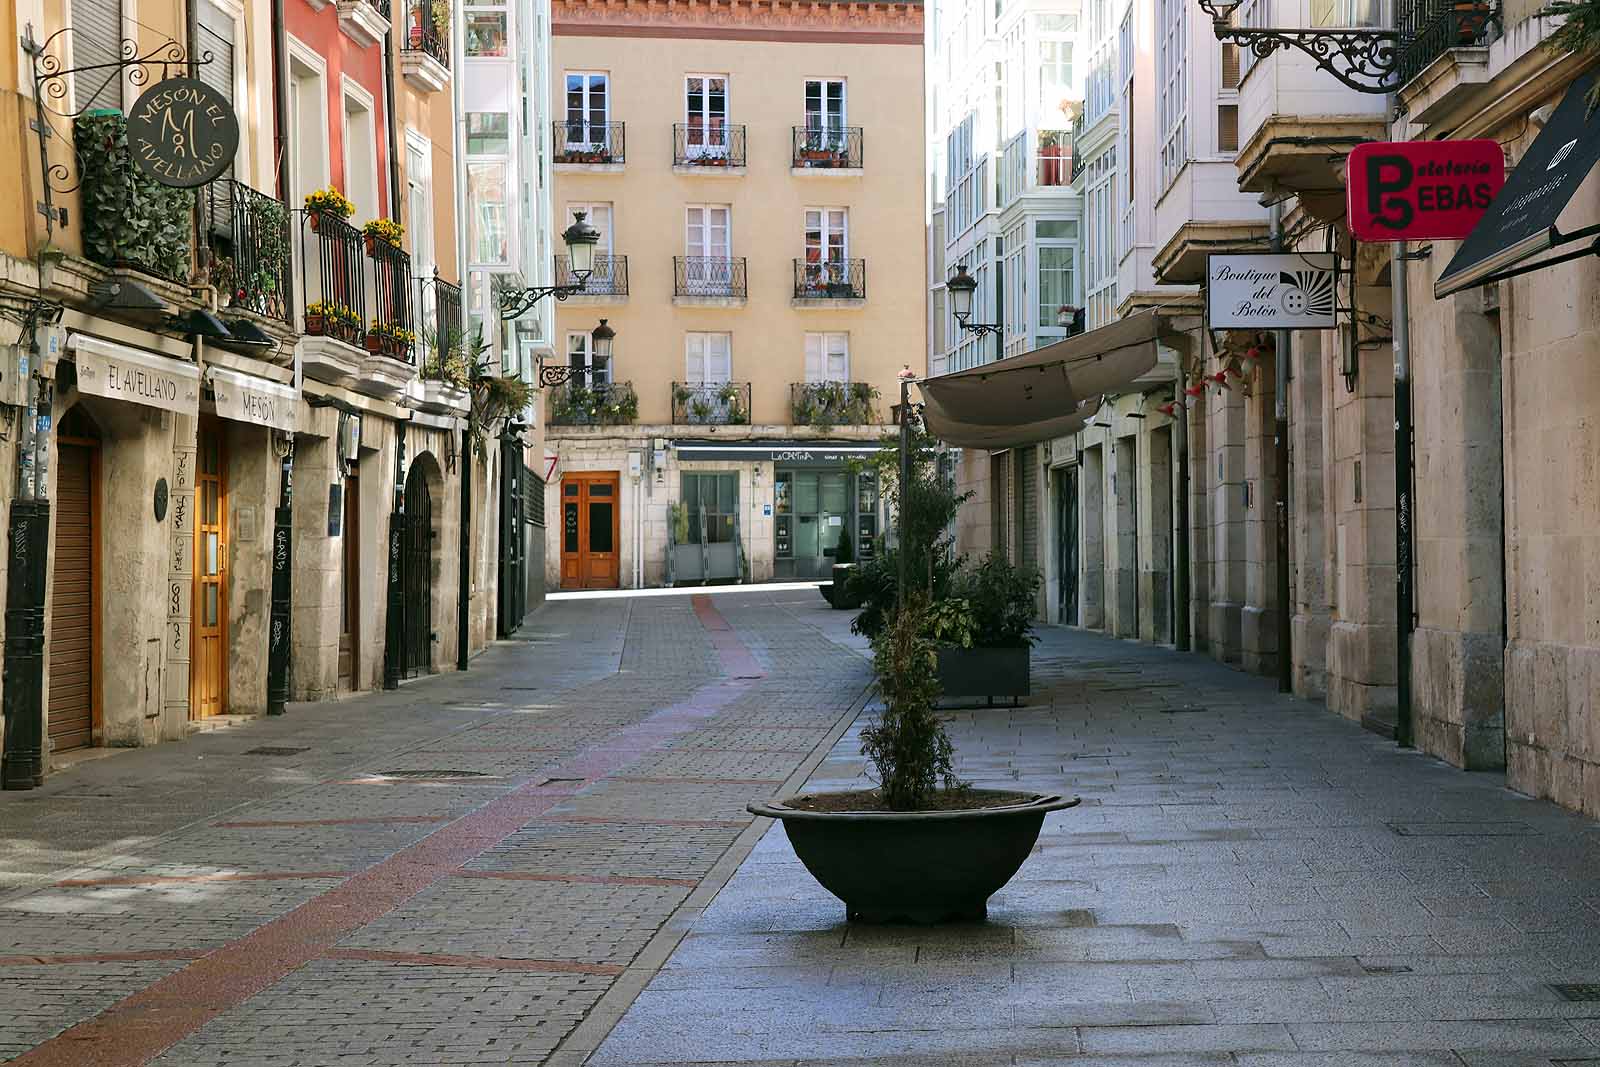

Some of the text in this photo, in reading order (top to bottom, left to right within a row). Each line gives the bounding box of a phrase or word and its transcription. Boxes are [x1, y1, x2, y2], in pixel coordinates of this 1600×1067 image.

[206, 104, 225, 127] EL
[137, 138, 224, 179] AVELLANO
[1211, 264, 1278, 284] Boutique
[1252, 284, 1276, 299] del
[1231, 300, 1278, 317] Botón
[108, 364, 122, 391] EL
[123, 369, 177, 401] AVELLANO
